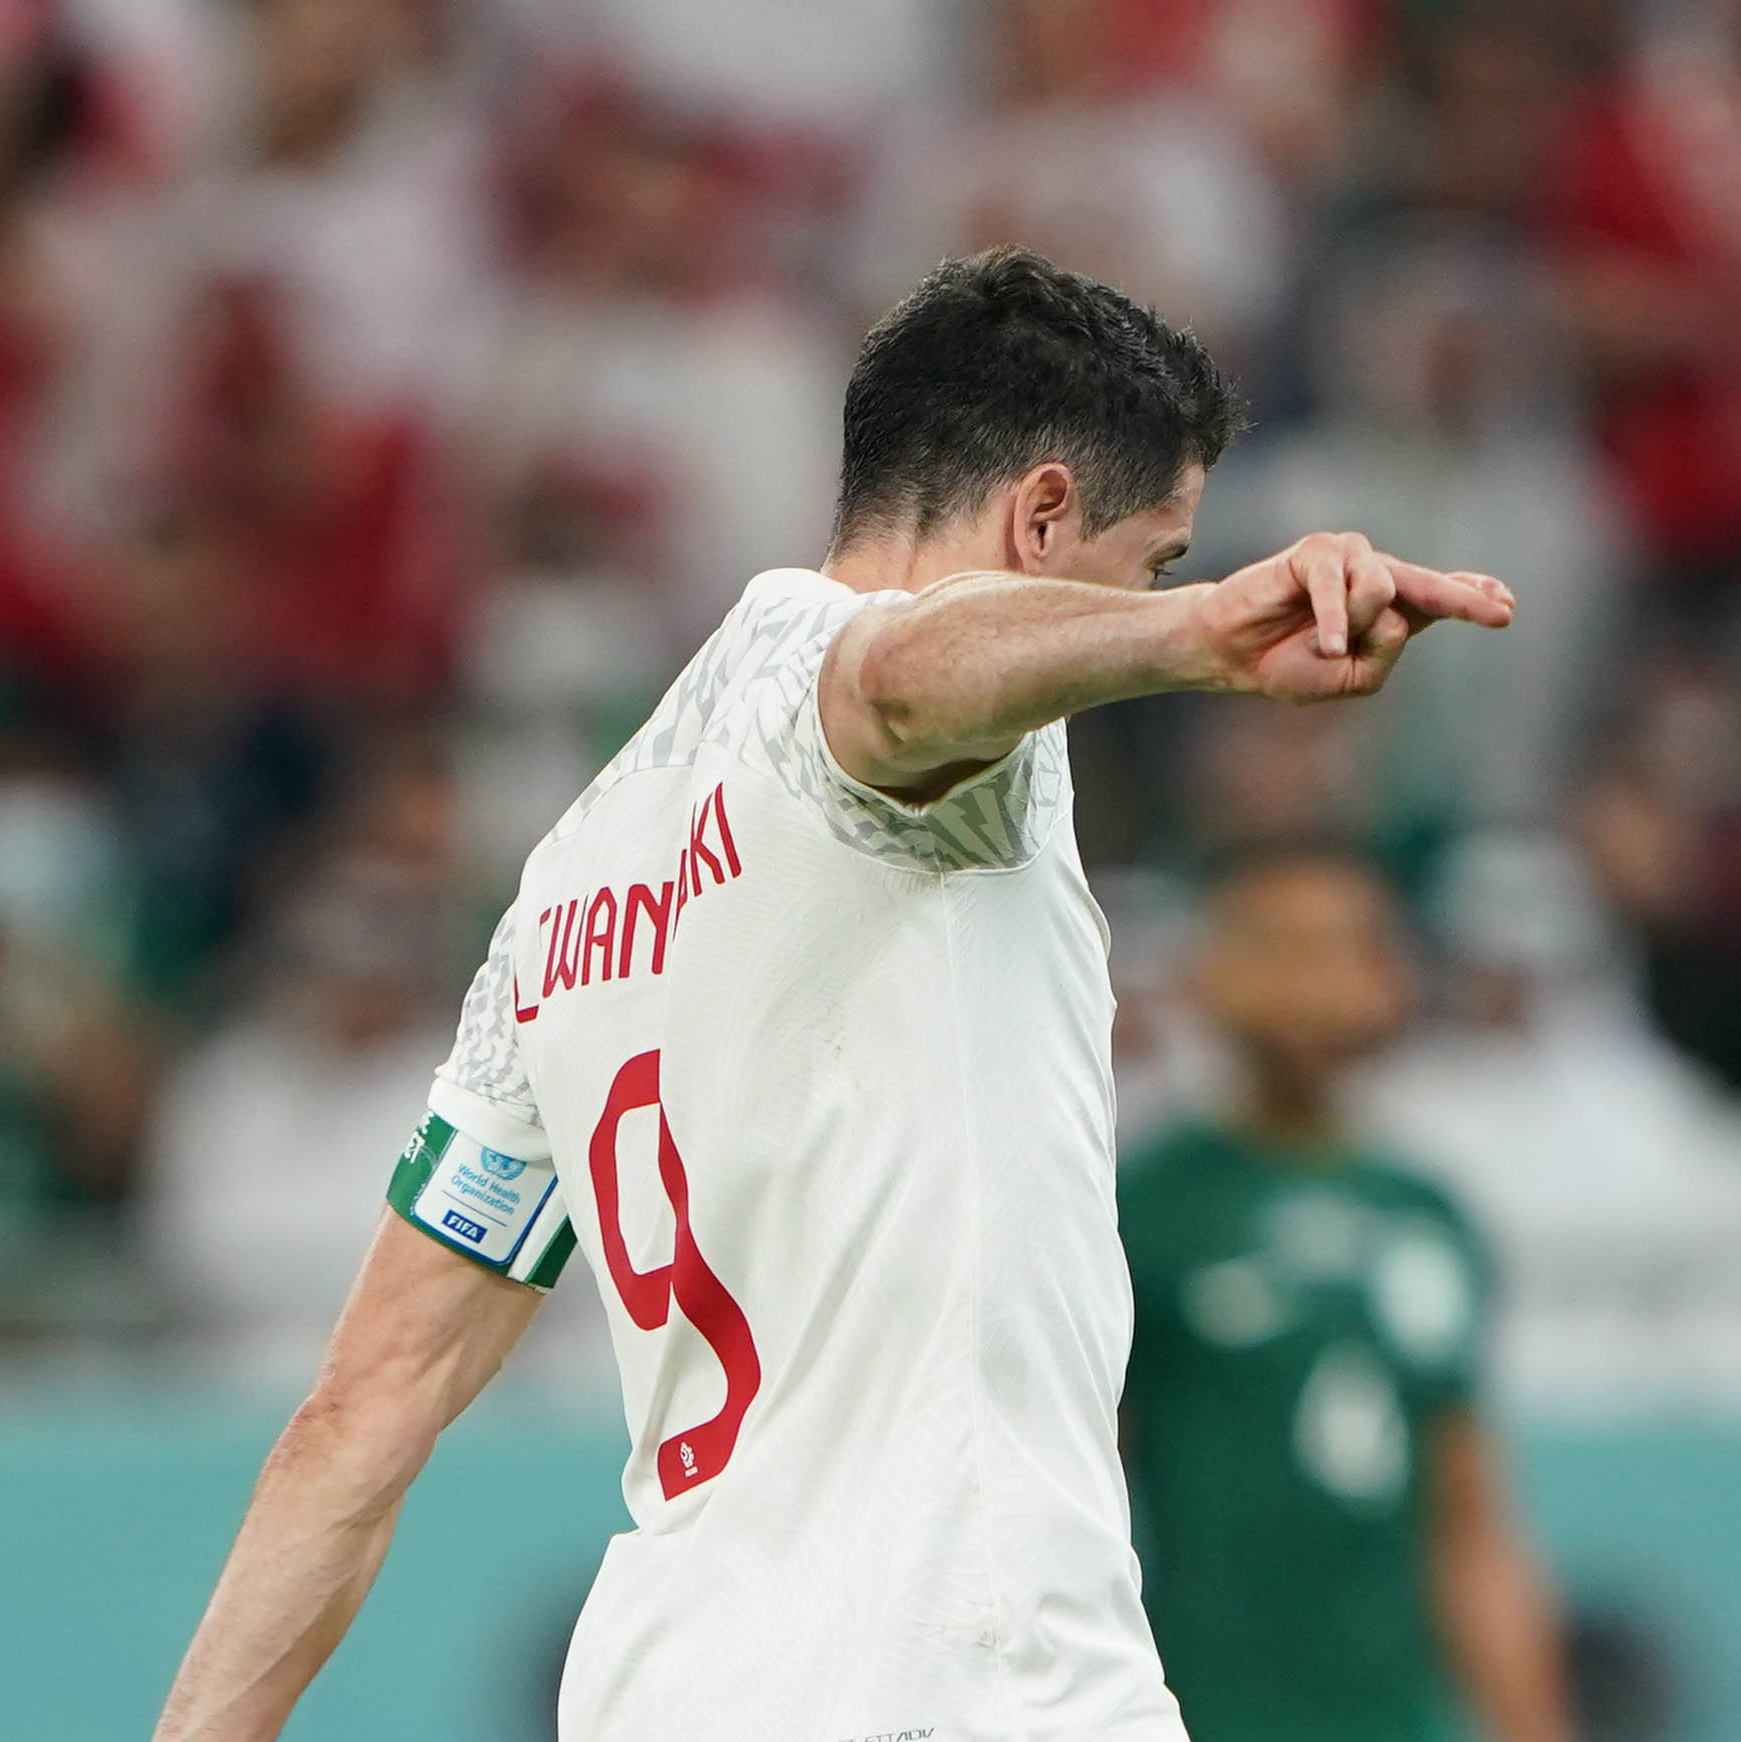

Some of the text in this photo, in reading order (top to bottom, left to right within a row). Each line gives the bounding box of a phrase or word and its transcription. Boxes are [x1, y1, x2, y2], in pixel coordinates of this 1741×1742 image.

[452, 1175, 515, 1215] Organization
[458, 1164, 521, 1204] World Health
[446, 1213, 480, 1239] FIFA
[589, 1048, 762, 1501] 9
